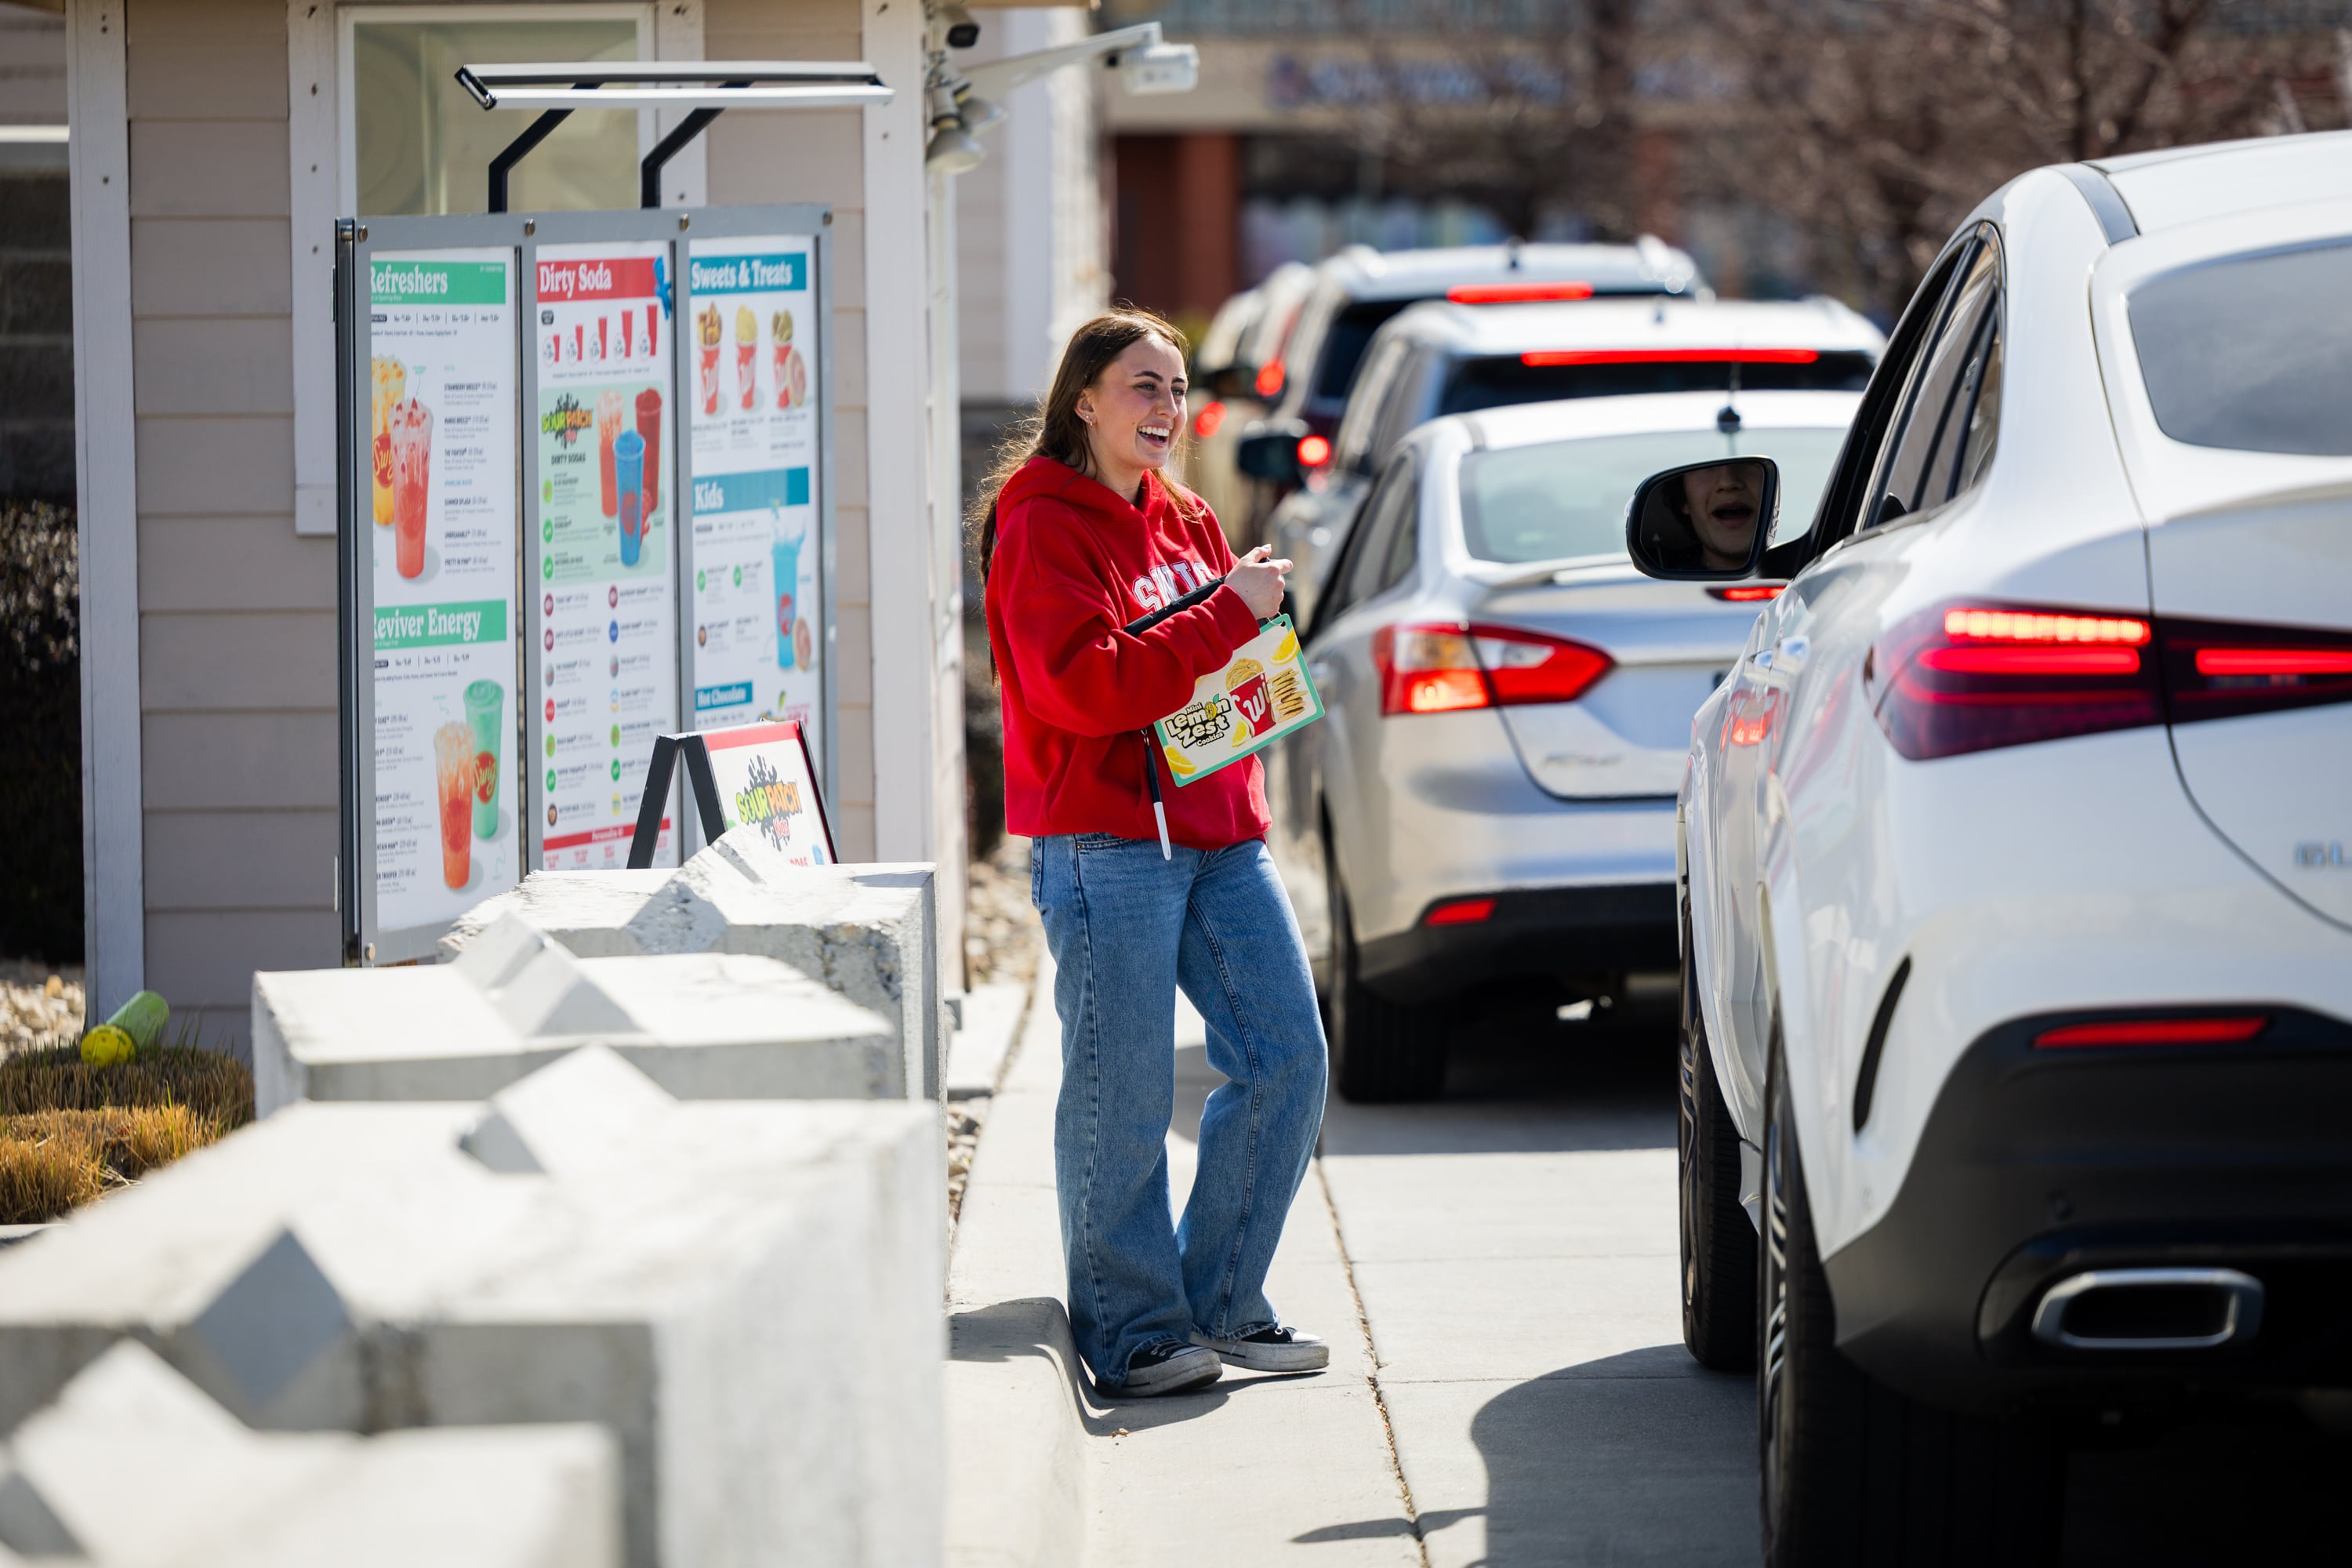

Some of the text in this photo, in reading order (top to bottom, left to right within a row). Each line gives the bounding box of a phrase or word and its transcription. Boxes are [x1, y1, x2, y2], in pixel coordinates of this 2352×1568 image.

[539, 261, 612, 299] Dirty Soda
[691, 260, 793, 290] Sweets & Treats
[542, 408, 593, 434] SOUR PATCH
[551, 452, 586, 465] DIRTY SODAS
[695, 481, 724, 511] Kids
[428, 608, 481, 641] Energy
[698, 686, 746, 707] Hot Chocolate
[1185, 702, 1203, 714] Mini
[1196, 731, 1225, 747] Cookies
[473, 758, 496, 795] Swig
[736, 781, 802, 826] SOUR PATCH
